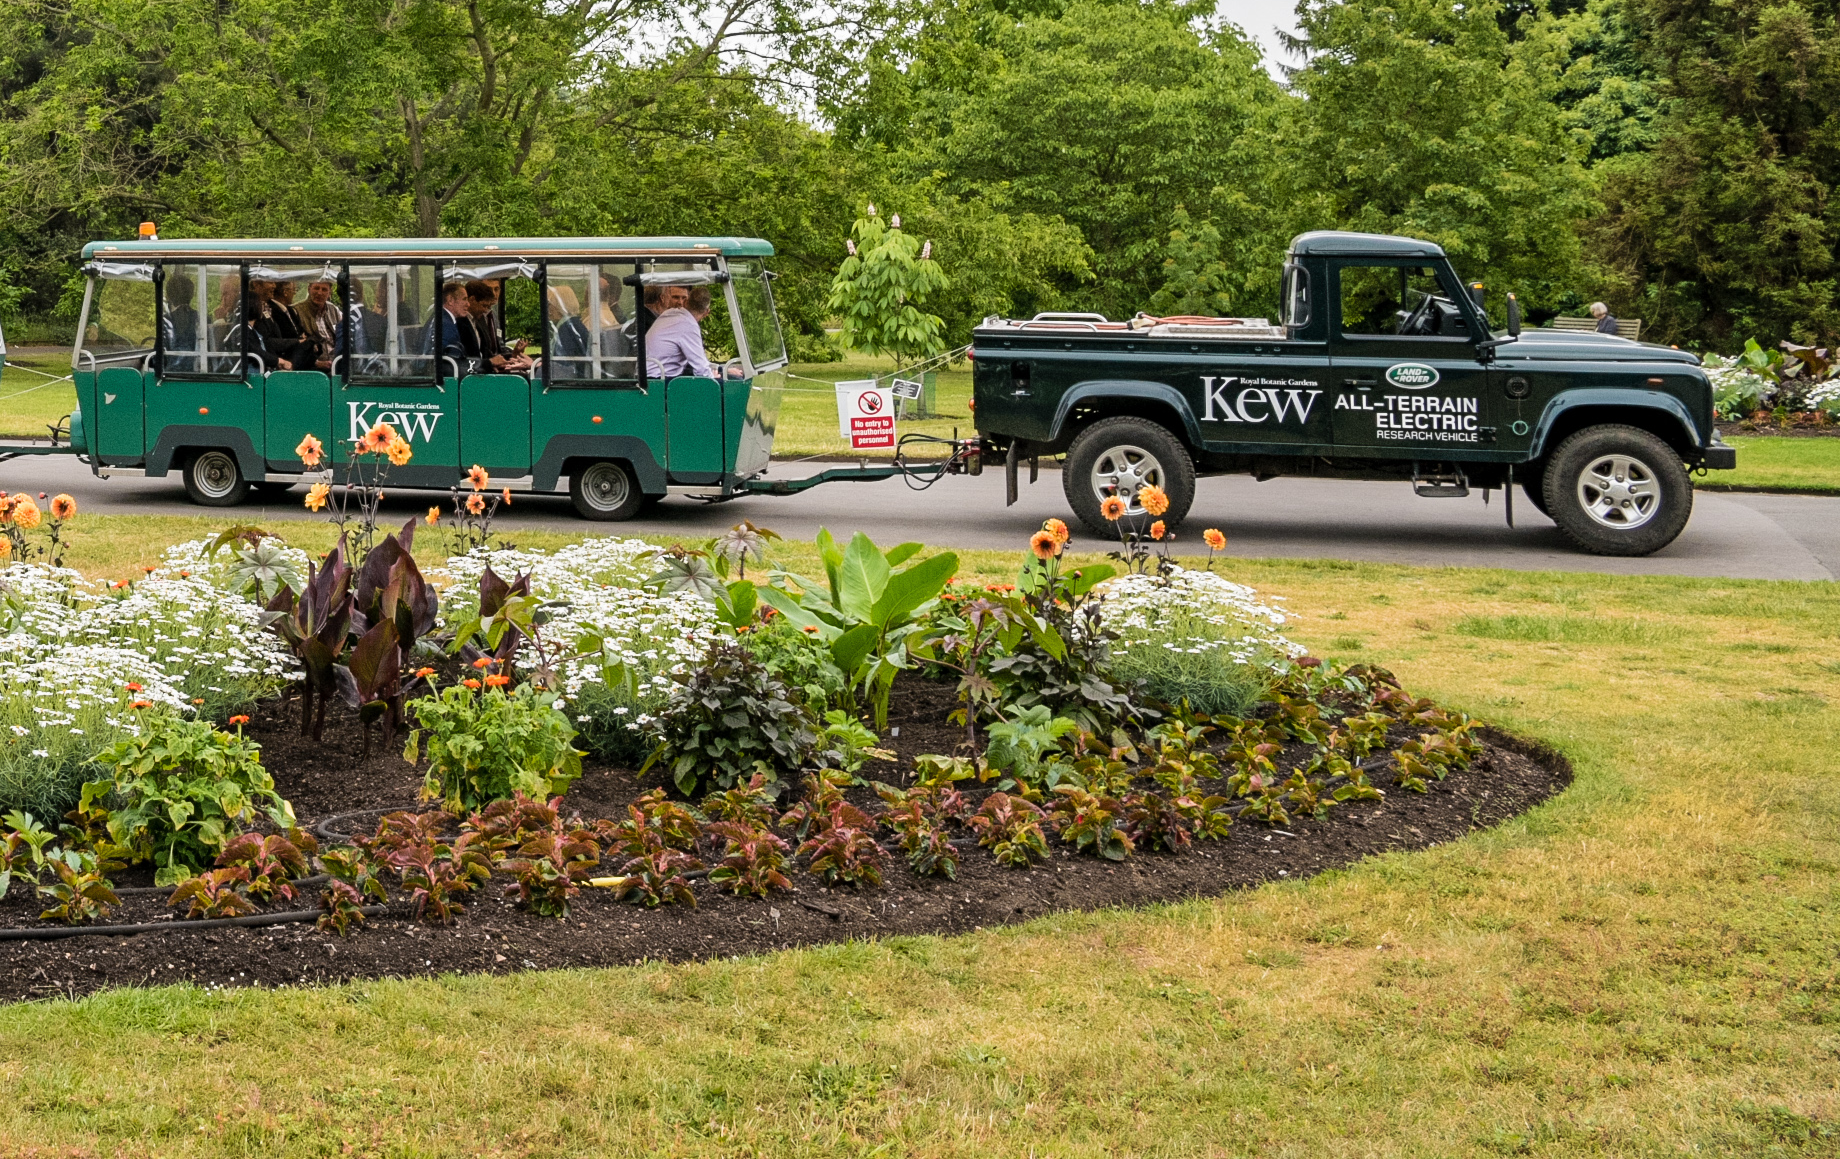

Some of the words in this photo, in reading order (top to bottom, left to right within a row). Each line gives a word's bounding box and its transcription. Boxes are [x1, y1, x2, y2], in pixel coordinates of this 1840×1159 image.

[1397, 368, 1422, 376] LAND
[1240, 377, 1260, 386] Royal
[1200, 376, 1323, 424] Kew
[1334, 394, 1477, 413] ALL-TERRAIN
[378, 402, 394, 410] Royal
[865, 420, 881, 428] entry
[1376, 413, 1478, 430] ELECTRIC
[852, 427, 893, 436] unauthorised
[1376, 430, 1433, 440] RESEARCH
[1435, 432, 1478, 442] VEHICLE
[858, 436, 888, 445] personnel
